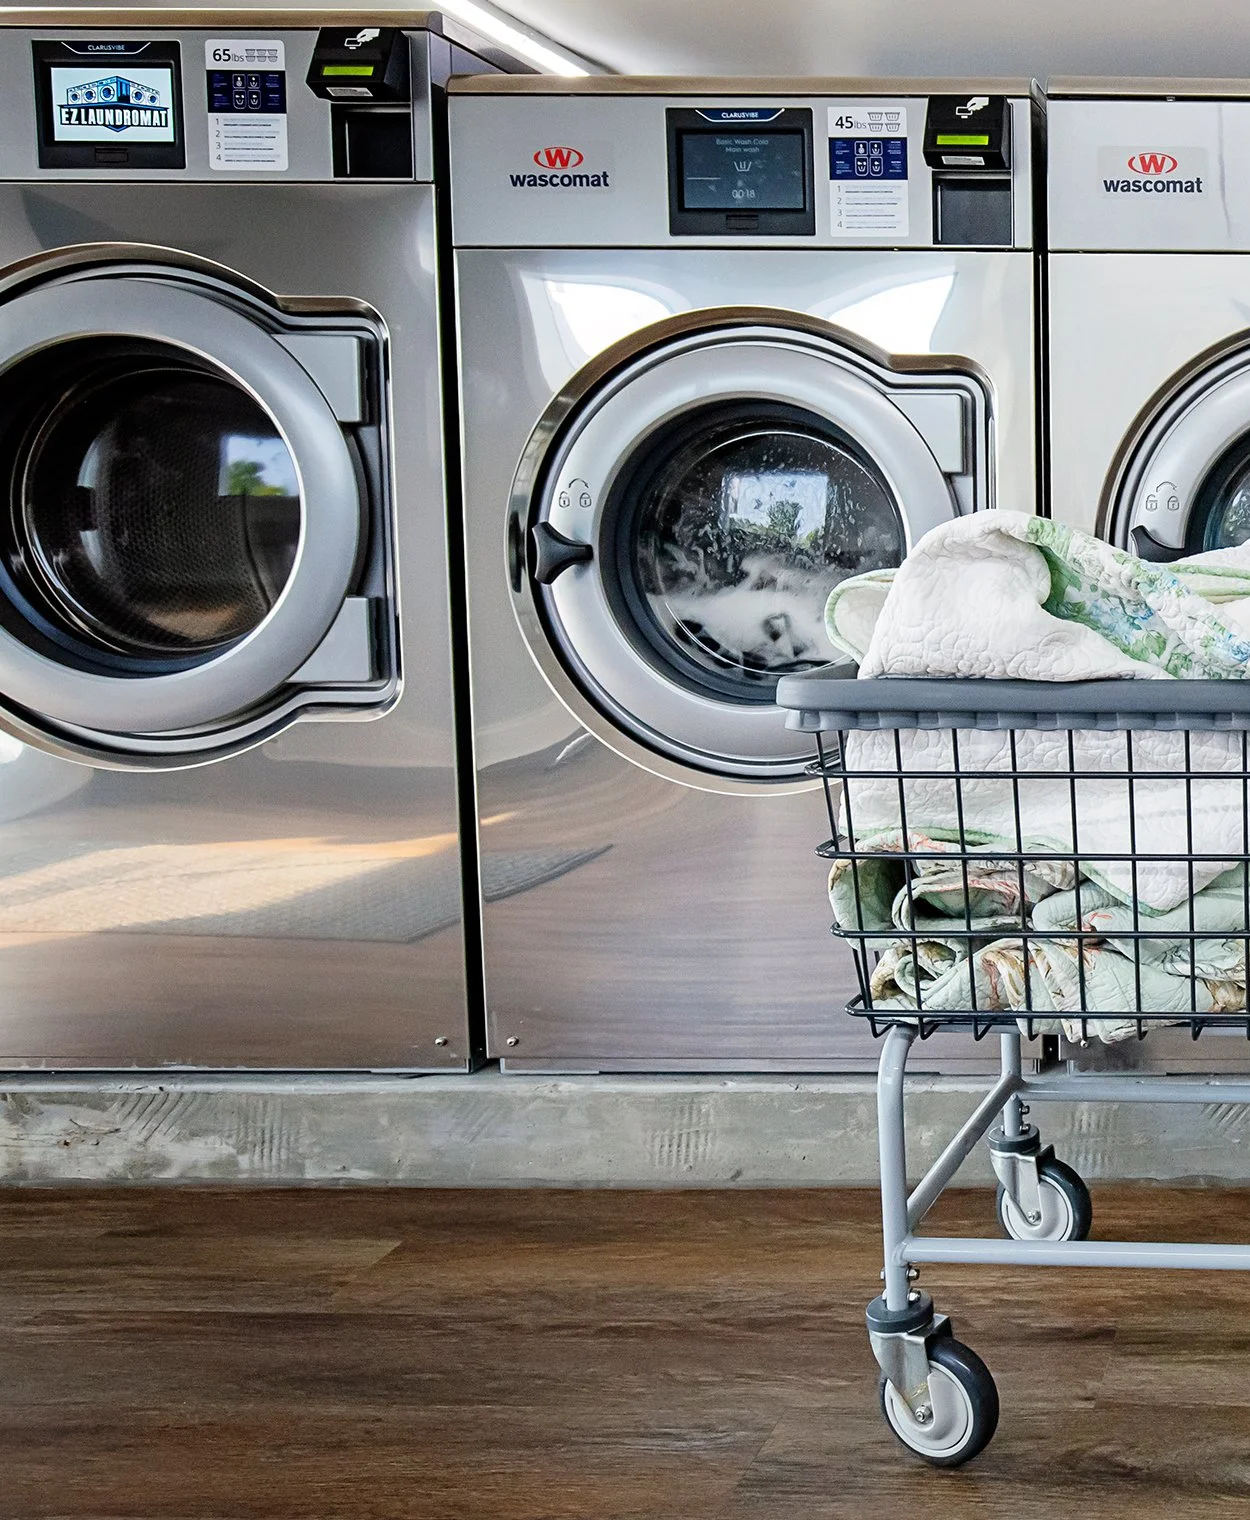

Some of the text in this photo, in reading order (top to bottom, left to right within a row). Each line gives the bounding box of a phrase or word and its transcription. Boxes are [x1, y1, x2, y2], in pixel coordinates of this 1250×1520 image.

[61, 108, 168, 127] EZ LAUNDROMAT
[510, 171, 609, 187] wascomat
[1103, 177, 1203, 193] wascomat
